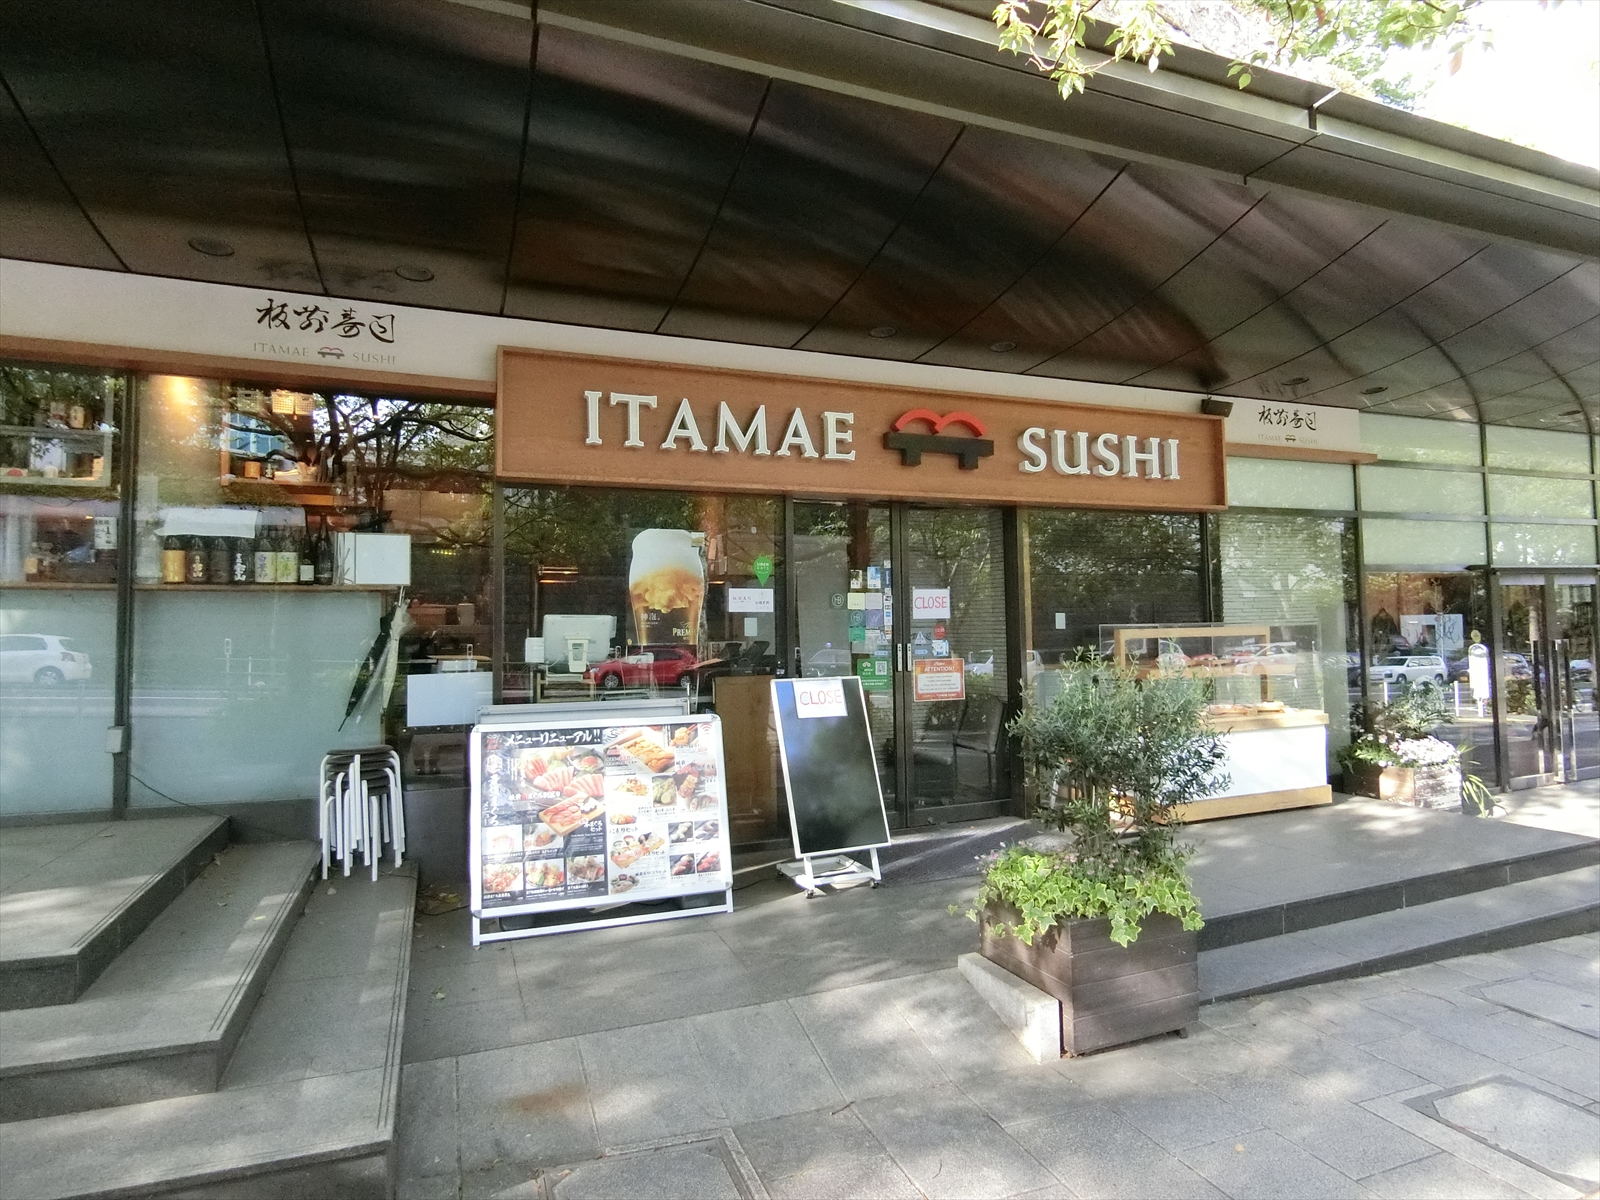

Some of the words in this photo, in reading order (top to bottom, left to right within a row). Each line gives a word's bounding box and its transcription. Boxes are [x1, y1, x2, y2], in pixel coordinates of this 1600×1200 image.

[253, 342, 310, 357] ITAMAE
[352, 352, 396, 365] SUSHI
[583, 390, 856, 461] ITAMAE
[1018, 426, 1181, 480] SUSHI
[914, 596, 948, 610] CLOSE
[924, 665, 956, 673] ATTENTION!
[800, 690, 843, 706] CLOSE
